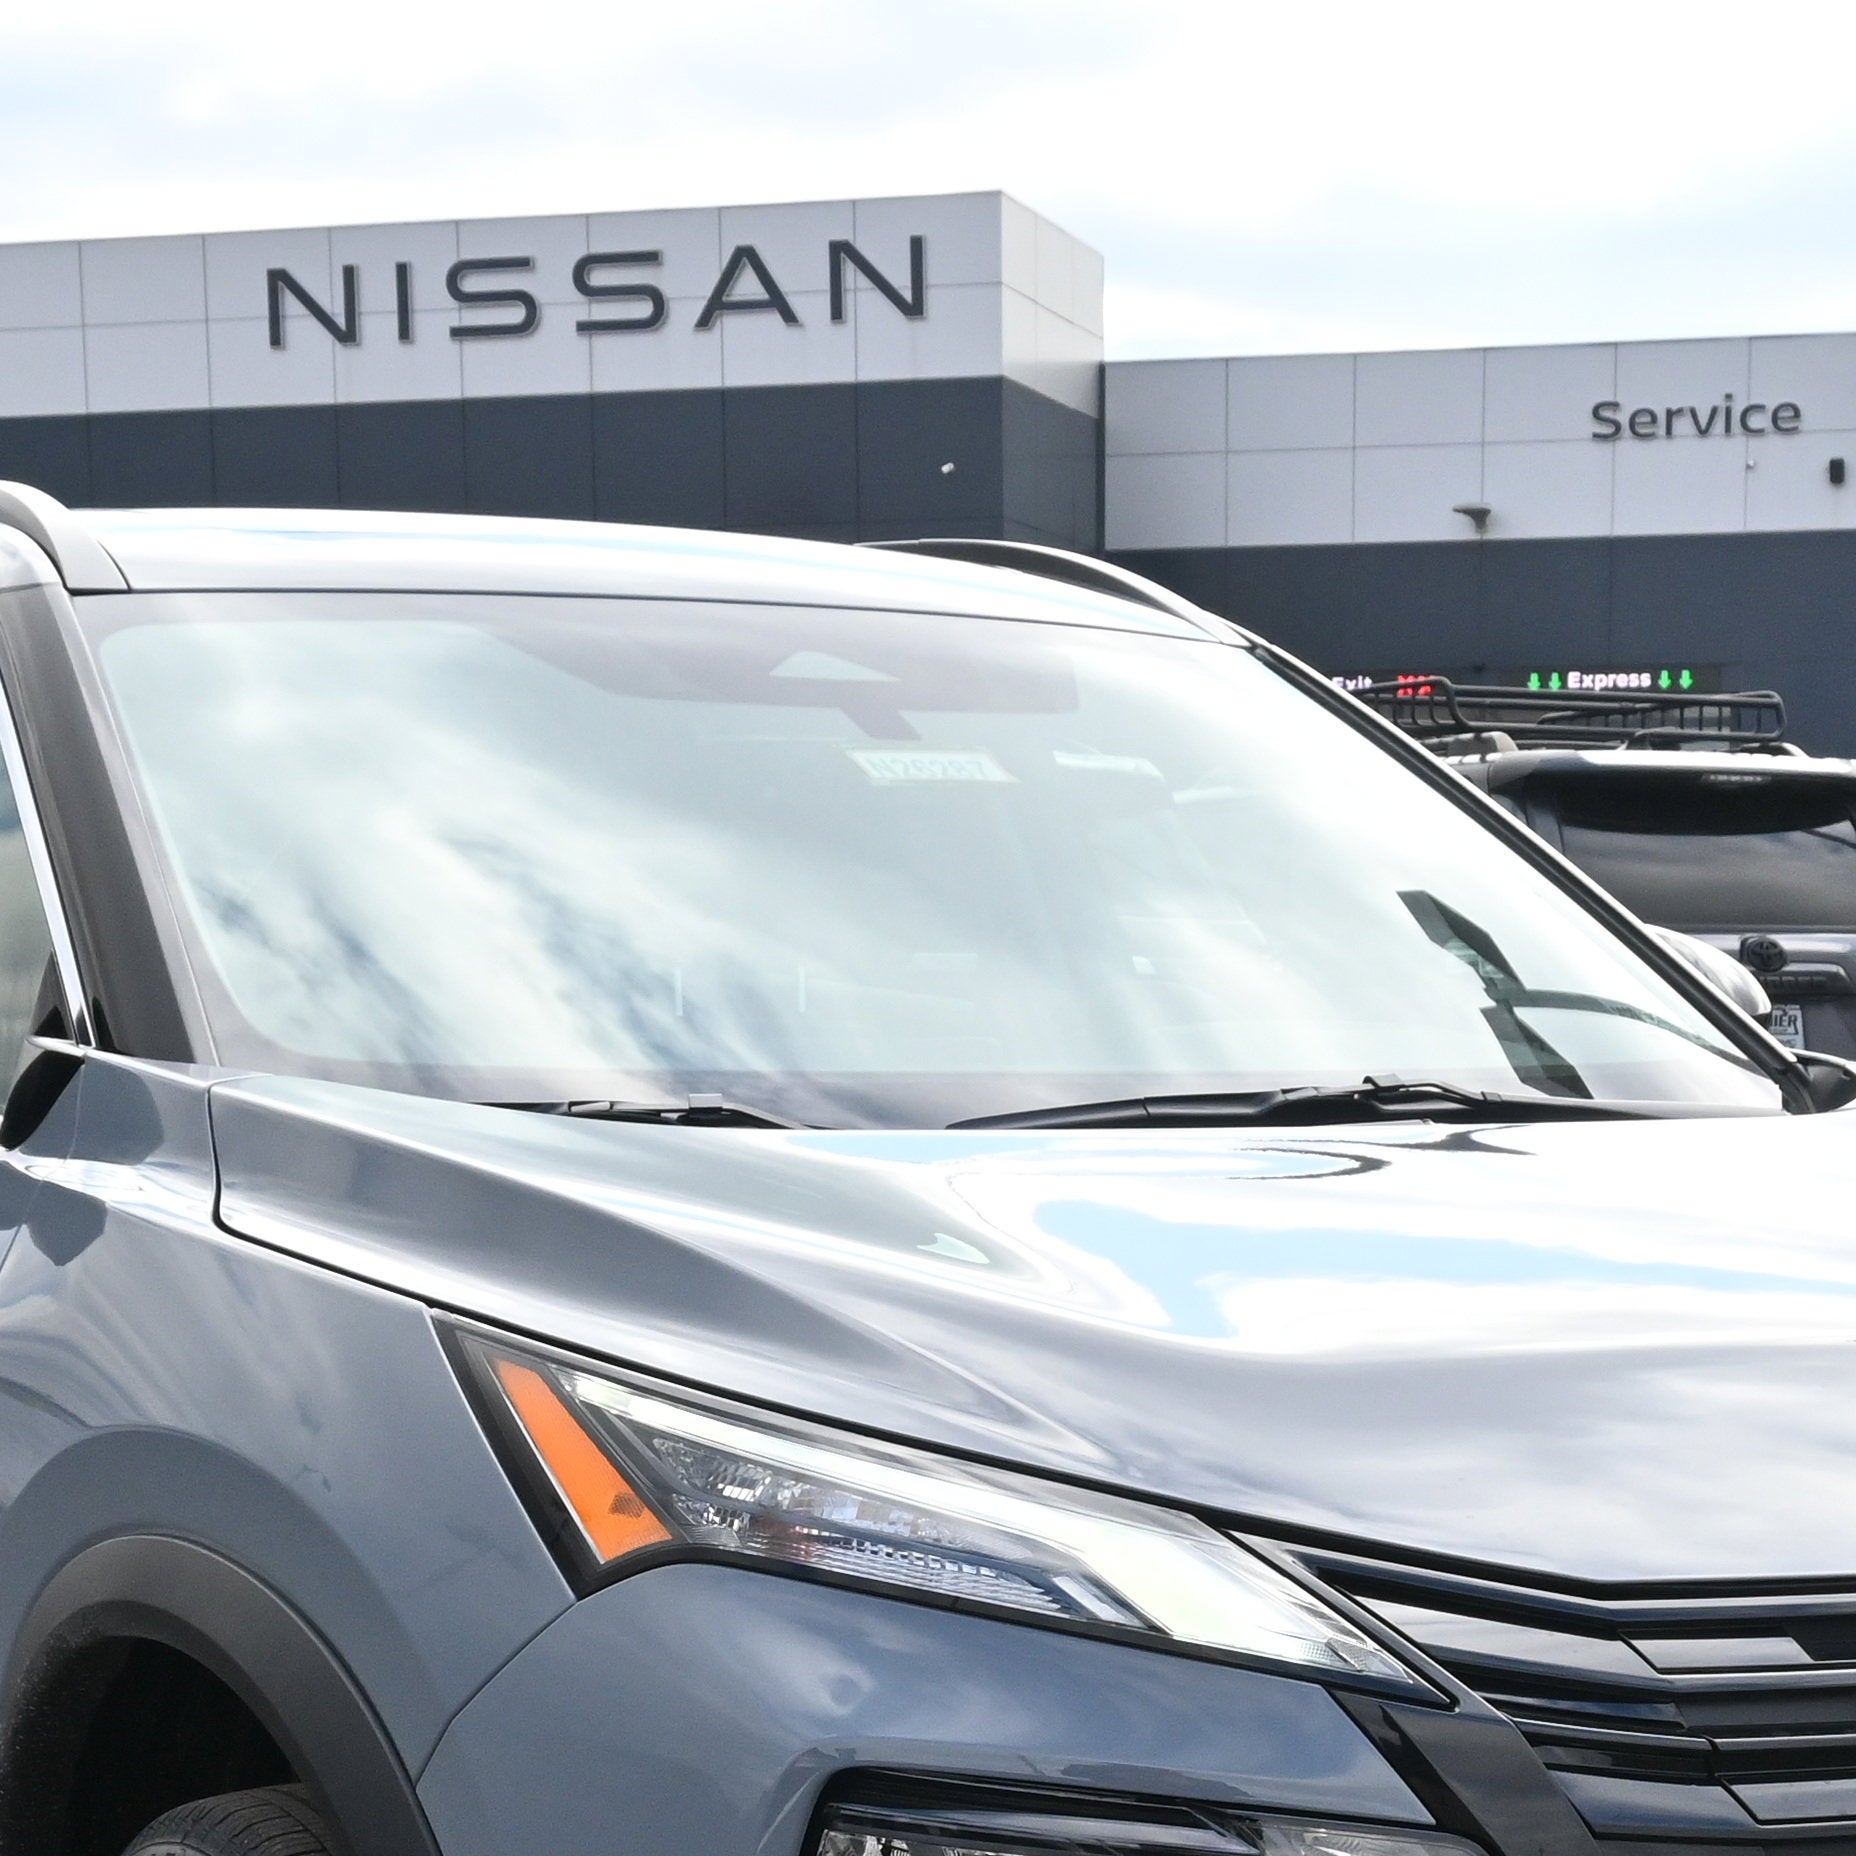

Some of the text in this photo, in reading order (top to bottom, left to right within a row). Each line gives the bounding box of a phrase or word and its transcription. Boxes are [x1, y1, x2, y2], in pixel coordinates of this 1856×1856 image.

[266, 234, 927, 350] NISSAN
[1591, 392, 1802, 440] Service
[1566, 671, 1652, 692] Express
